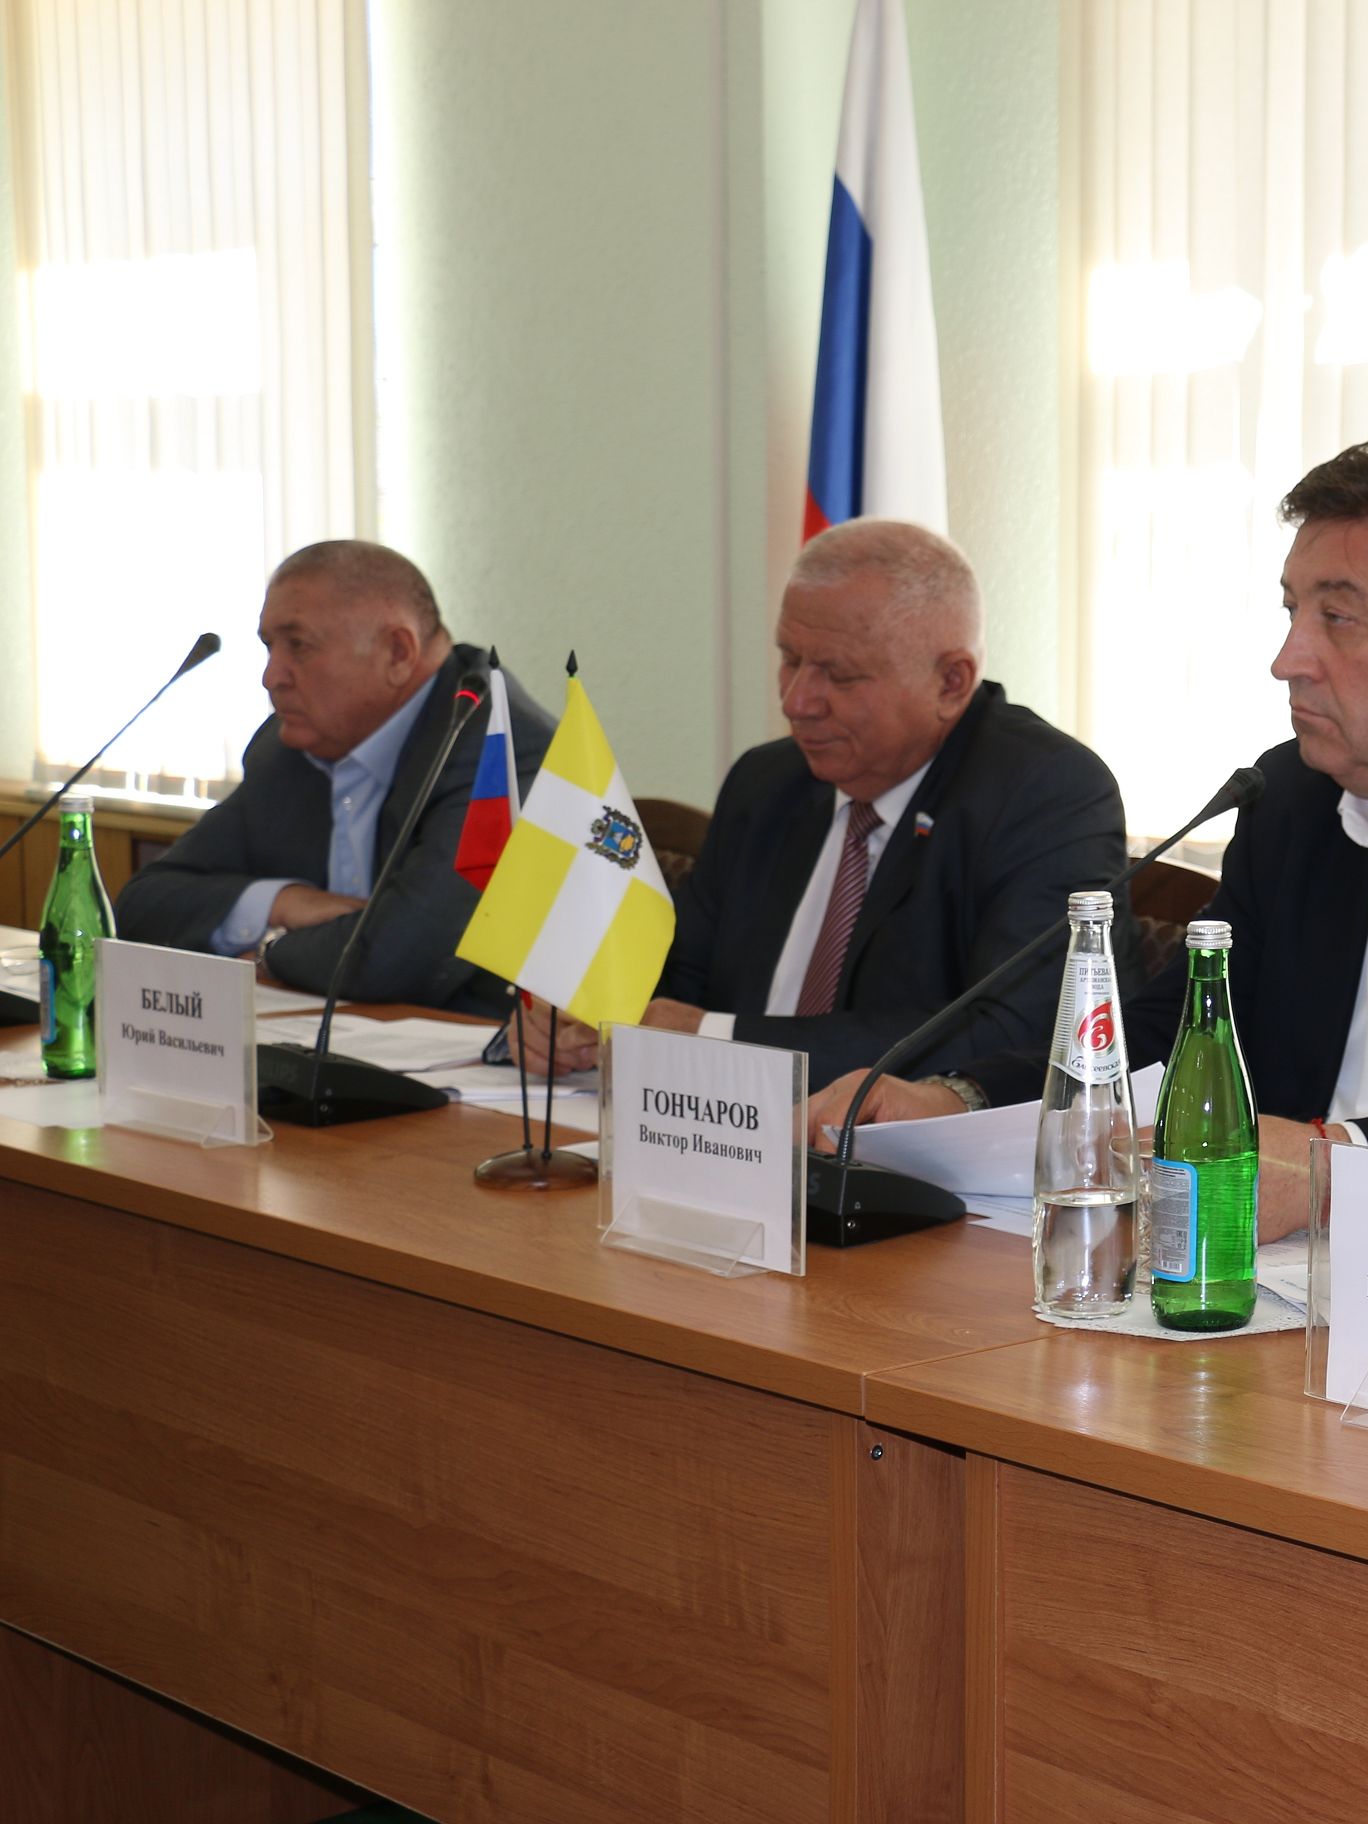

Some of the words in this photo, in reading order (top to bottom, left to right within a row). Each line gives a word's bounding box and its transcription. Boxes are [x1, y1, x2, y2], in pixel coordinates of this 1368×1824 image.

[141, 987, 203, 1019] БЕЛЫЙ
[122, 1023, 156, 1046] Юрий
[158, 1029, 226, 1057] Васильевич
[642, 1087, 760, 1131] ГОНЧАРОВ
[639, 1123, 689, 1155] Виктор
[692, 1133, 763, 1164] Иванович
